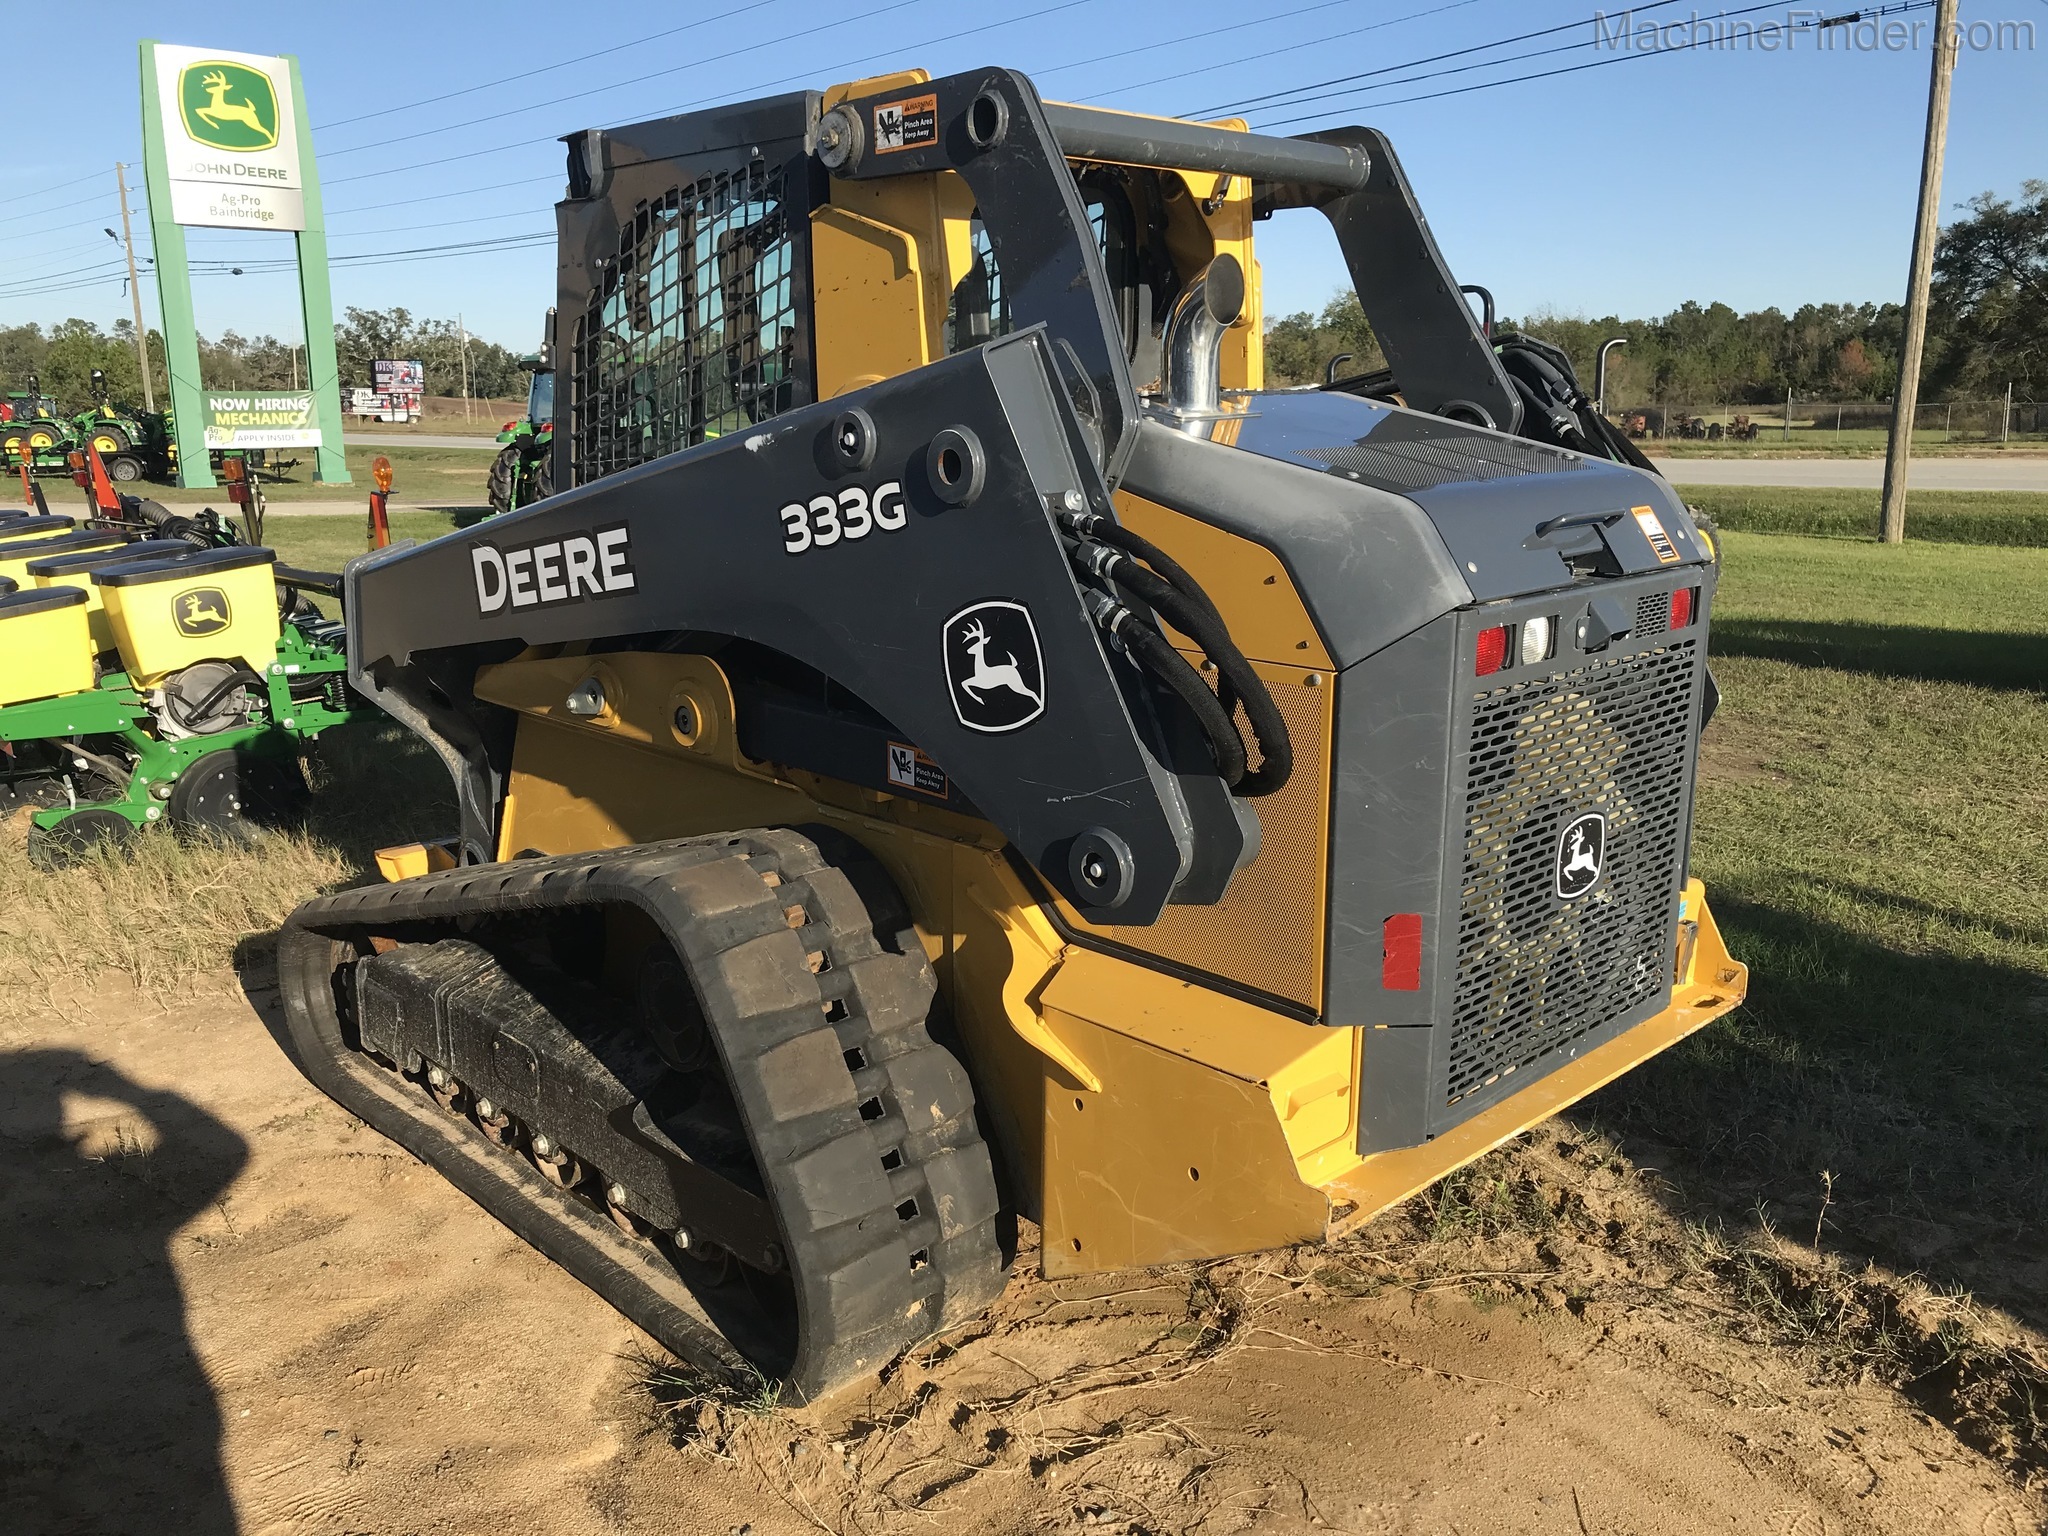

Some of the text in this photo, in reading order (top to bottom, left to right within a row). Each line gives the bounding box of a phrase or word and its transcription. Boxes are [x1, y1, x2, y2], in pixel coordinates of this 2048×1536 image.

[904, 118, 933, 130] Pinch Area
[904, 129, 930, 139] Keep Away
[187, 162, 288, 180] JOHN DEERE
[221, 193, 260, 206] Ag-Pro
[209, 206, 274, 221] Bainbridge
[209, 398, 310, 411] NOW HIRING
[215, 412, 307, 425] MECHANICS
[237, 434, 264, 442] APPLY
[780, 482, 907, 553] 333G
[471, 527, 635, 612] DEERE
[916, 767, 944, 780] Pinch Area
[916, 777, 940, 789] Keep Away
